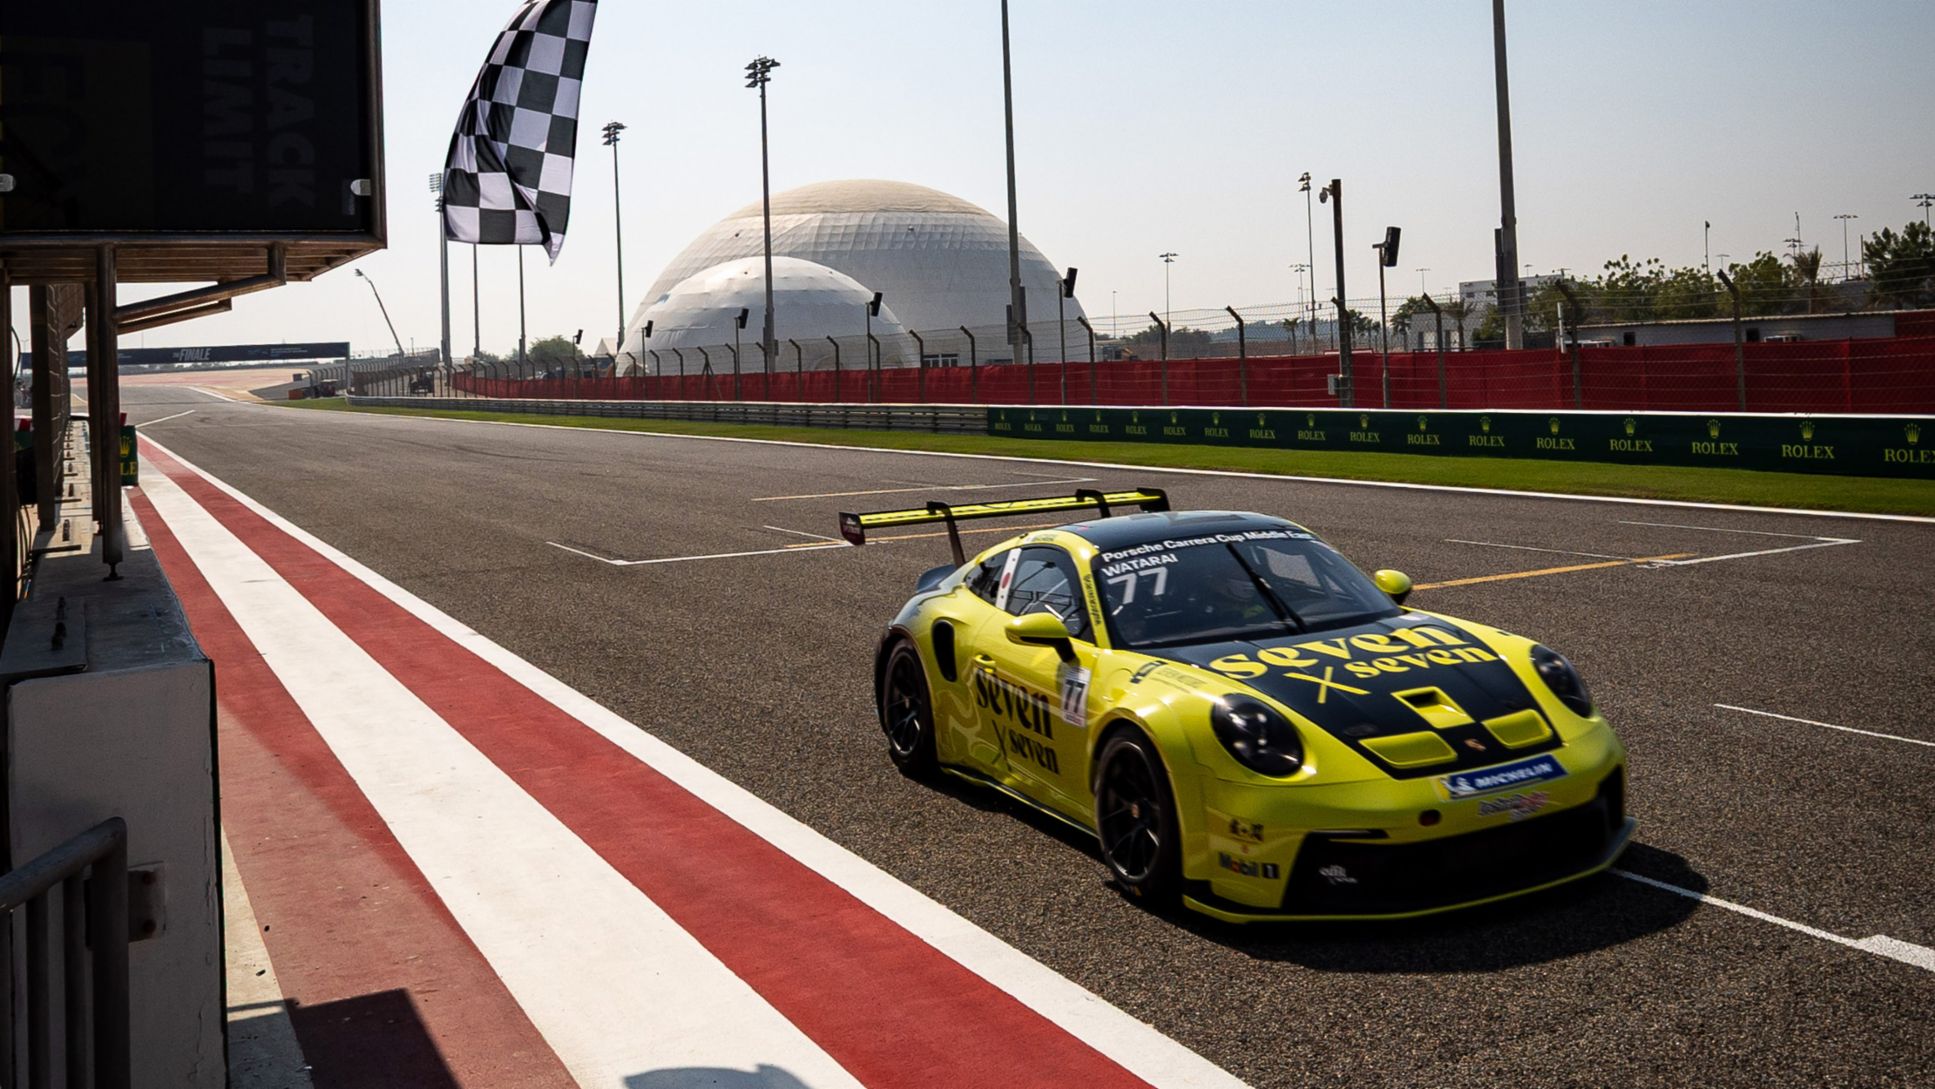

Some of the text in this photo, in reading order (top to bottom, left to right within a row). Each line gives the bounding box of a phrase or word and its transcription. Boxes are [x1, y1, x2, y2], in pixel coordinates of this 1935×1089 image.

[201, 27, 255, 194] LIMIT
[266, 14, 316, 209] TRACK
[179, 348, 211, 361] FINALE
[1056, 424, 1074, 432] ROLEX
[1089, 424, 1109, 433] ROLEX
[1125, 425, 1147, 435] ROLEX
[1164, 426, 1186, 436] ROLEX
[1204, 427, 1229, 438] ROLEX
[1250, 429, 1276, 440] ROLEX
[1297, 430, 1326, 441] ROLEX
[1350, 431, 1380, 442] ROLEX
[1408, 434, 1440, 445] ROLEX
[1469, 435, 1505, 447] ROLEX
[1536, 437, 1575, 450] ROLEX
[1609, 439, 1653, 452] ROLEX
[1691, 442, 1739, 455] ROLEX
[1781, 444, 1836, 459] ROLEX
[1101, 543, 1164, 563] Porsche
[1164, 531, 1218, 550] Carrera
[1216, 531, 1246, 543] Cup
[1101, 553, 1179, 578] WATARAI
[1107, 566, 1169, 605] 77
[1209, 625, 1472, 680] seven
[1344, 646, 1500, 679] seven
[975, 671, 1054, 740] seven
[1064, 679, 1085, 713] 77
[1008, 728, 1059, 774] seven
[1473, 762, 1553, 788] MICHELIN
[1218, 852, 1259, 878] Mobil
